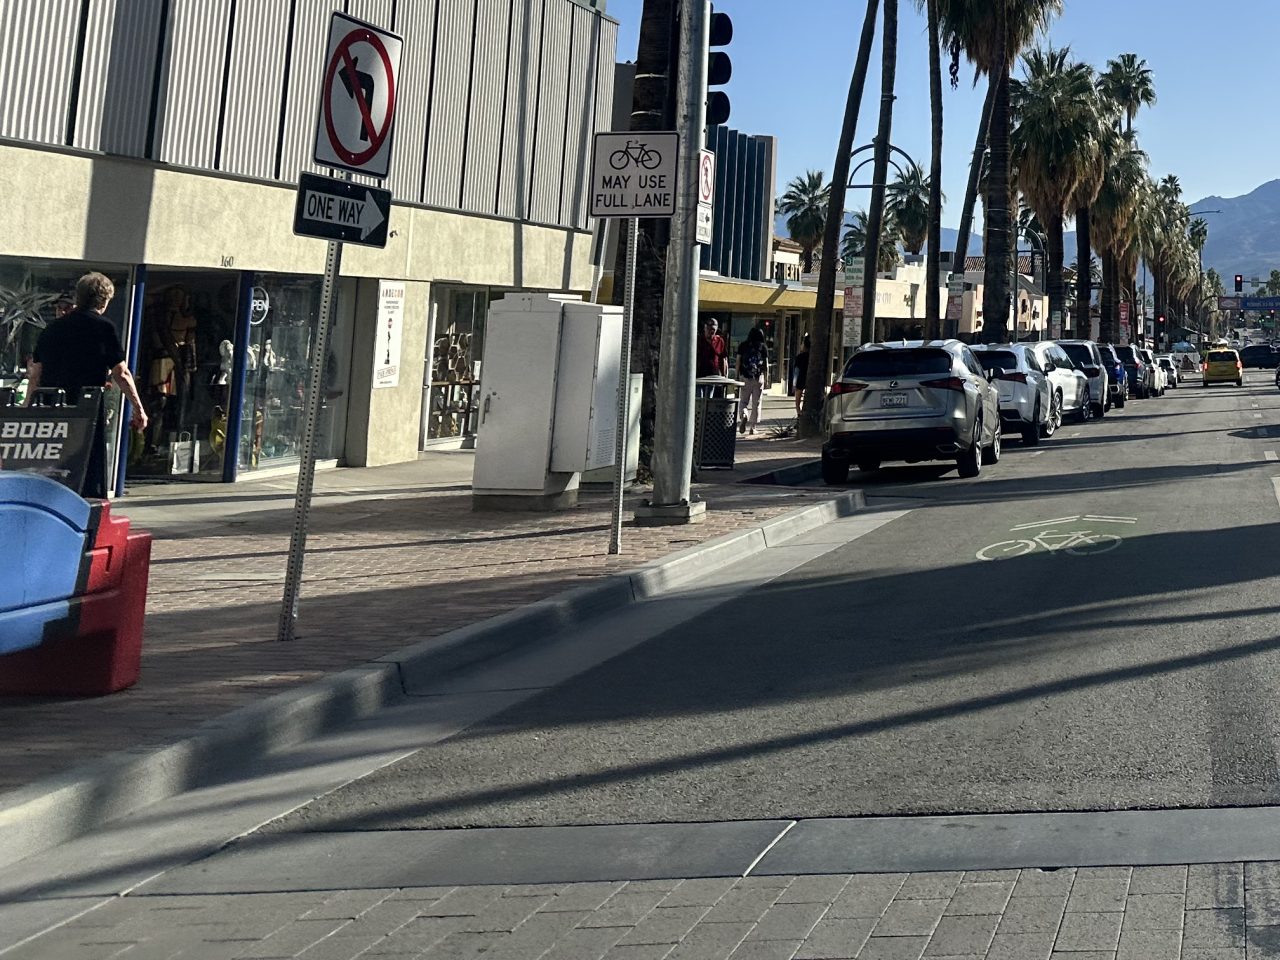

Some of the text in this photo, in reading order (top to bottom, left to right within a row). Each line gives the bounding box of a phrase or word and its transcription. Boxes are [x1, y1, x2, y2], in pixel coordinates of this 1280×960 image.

[602, 175, 667, 189] MAY USE
[595, 193, 671, 207] FULL LANE
[307, 193, 365, 225] ONE WAY
[221, 254, 234, 268] 160
[251, 299, 269, 311] PEN
[1, 422, 69, 438] BOBA
[0, 443, 63, 460] TIME
